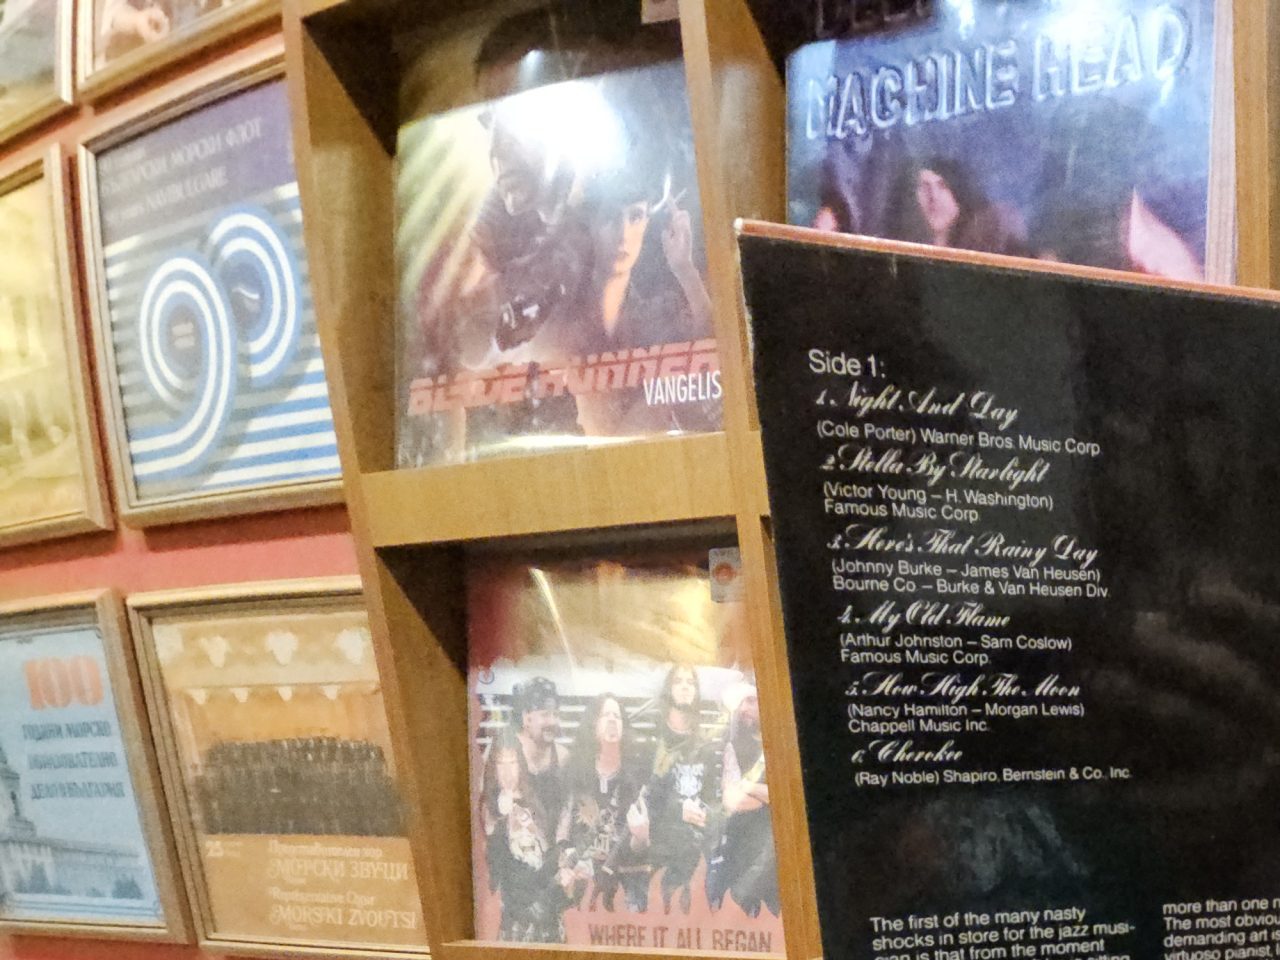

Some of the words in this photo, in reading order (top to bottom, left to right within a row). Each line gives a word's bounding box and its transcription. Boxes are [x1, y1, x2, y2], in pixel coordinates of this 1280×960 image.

[805, 40, 1016, 139] MACHINE
[1032, 5, 1192, 102] HEAD
[808, 349, 861, 376] Side
[867, 355, 886, 378] 1:
[643, 369, 723, 406] VANGELIS
[848, 381, 902, 417] Night
[899, 387, 964, 416] And
[969, 390, 1018, 430] Day
[817, 420, 859, 438] (Cole
[864, 422, 916, 444] Porter)
[920, 427, 974, 446] Warner
[1019, 435, 1060, 452] Music
[838, 445, 904, 472] Stella
[907, 451, 946, 486] By
[950, 451, 1051, 491] Starlight
[824, 482, 873, 499] (Victor
[877, 484, 926, 505] Young
[965, 490, 1053, 511] Washington)
[825, 500, 887, 517] Famous
[893, 502, 936, 519] Music
[845, 523, 914, 552] Here's
[918, 528, 973, 555] That
[974, 532, 1047, 567] Rainy
[1052, 534, 1098, 569] Day
[832, 559, 893, 577] (Johnny
[899, 560, 942, 576] Burke
[961, 563, 1009, 578] James
[1013, 564, 1039, 579] Van
[1044, 566, 1101, 582] Heusen)
[833, 577, 889, 592] Bourne
[937, 578, 979, 594] Burke
[985, 580, 994, 594] &
[999, 581, 1025, 595] Van
[1029, 582, 1082, 597] Heusen
[868, 600, 902, 633] My
[906, 601, 947, 626] Old
[947, 602, 1011, 627] Flame
[840, 634, 890, 649] (Arthur
[895, 634, 962, 648] Johnston
[981, 635, 1012, 649] Sam
[1016, 635, 1073, 651] Coslow)
[841, 650, 901, 664] Famous
[906, 650, 948, 664] Music
[863, 672, 918, 697] How
[921, 672, 985, 704] High
[983, 673, 1020, 697] The
[1022, 674, 1080, 697] Moon
[848, 704, 899, 720] (Nancy
[904, 704, 968, 717] Hamilton
[985, 704, 1038, 719] Morgan
[1042, 703, 1085, 717] Lewis)
[848, 719, 915, 735] Chappell
[920, 720, 961, 733] Music
[868, 740, 963, 763] Cherokee
[855, 771, 887, 788] (Ray
[892, 771, 940, 786] Noble)
[1003, 768, 1064, 782] Bernstein
[1069, 767, 1079, 780] &
[1163, 902, 1201, 914] more
[1206, 899, 1237, 913] than
[1241, 897, 1268, 910] one
[870, 916, 904, 933] The
[908, 914, 939, 930] first
[943, 912, 960, 928] of
[964, 911, 990, 927] the
[995, 908, 1040, 925] many
[1044, 906, 1086, 922] nasty
[588, 923, 646, 946] WHERE
[653, 925, 667, 947] IT
